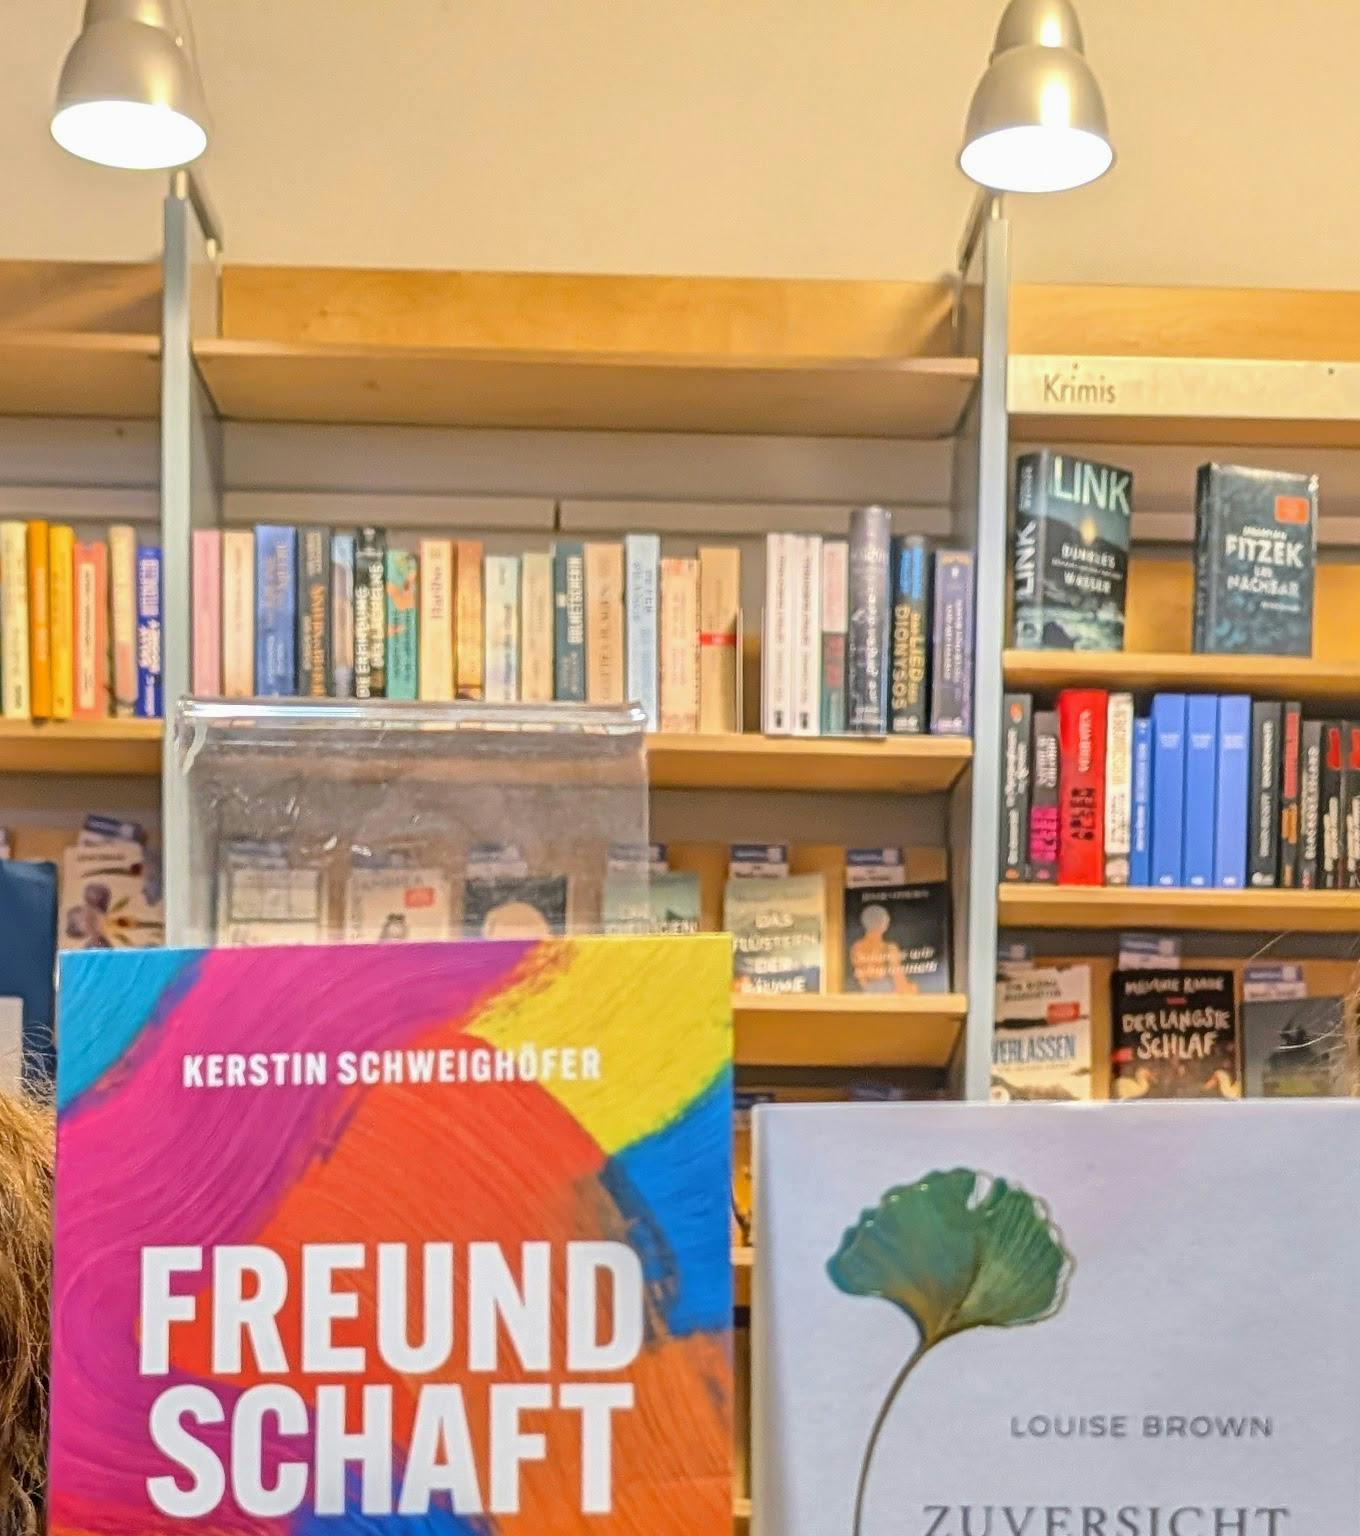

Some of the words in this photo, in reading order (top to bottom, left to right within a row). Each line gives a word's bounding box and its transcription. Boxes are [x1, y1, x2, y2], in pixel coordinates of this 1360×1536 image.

[1042, 368, 1117, 405] Krimis
[1054, 455, 1131, 518] LINK
[1015, 520, 1037, 600] LINK
[1225, 534, 1304, 569] FITZEK
[183, 1051, 327, 1088] KERSTIN
[338, 1042, 601, 1085] SCHWEIGHÖFER
[139, 1240, 644, 1376] FREUND
[145, 1380, 635, 1519] SCHAFT
[1011, 1415, 1128, 1438] LOUISE
[1142, 1415, 1275, 1438] BROWN
